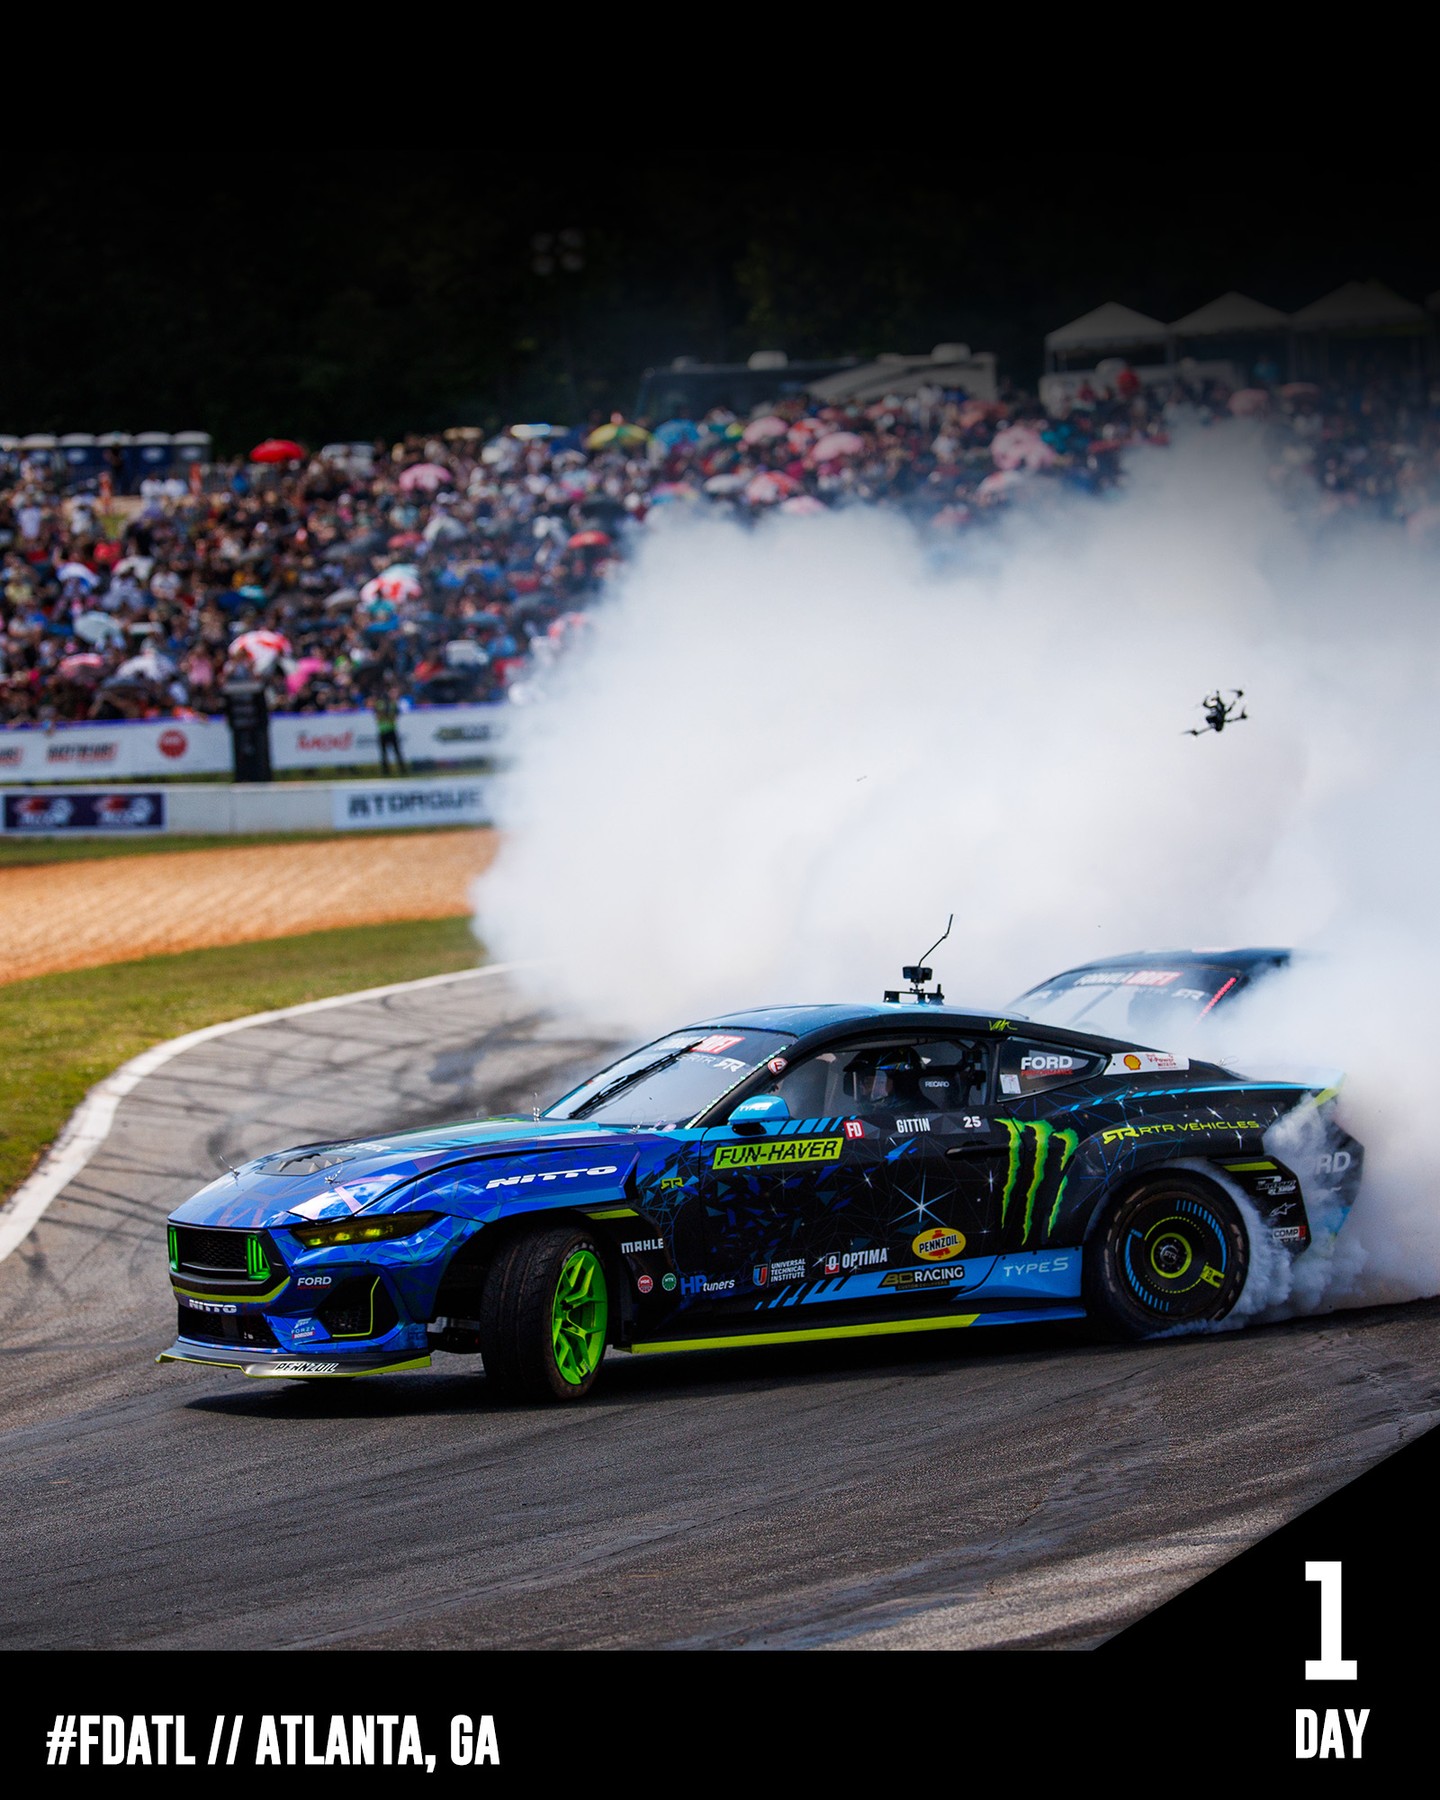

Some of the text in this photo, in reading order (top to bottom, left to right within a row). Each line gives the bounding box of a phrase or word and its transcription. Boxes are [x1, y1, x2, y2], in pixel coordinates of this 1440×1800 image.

[1021, 1055, 1073, 1070] FORD
[925, 1080, 949, 1088] RECARO
[896, 1117, 931, 1134] GITTIN
[963, 1115, 982, 1128] 25
[1139, 1124, 1176, 1136] RTR
[1176, 1120, 1260, 1132] VEHICLES
[717, 1140, 838, 1166] FUN-HAVER
[485, 1165, 618, 1190] NITTO
[1274, 1229, 1298, 1238] COMP
[621, 1238, 664, 1254] MAHLE
[919, 1236, 959, 1254] PENNZOIL
[771, 1258, 806, 1270] UNIVERSAL
[842, 1247, 888, 1269] OPTIMA
[770, 1271, 805, 1283] INSTITUTE
[771, 1265, 806, 1276] TECHNICAL
[297, 1276, 332, 1286] FORD
[189, 1299, 237, 1314] NITTO
[291, 1326, 316, 1335] FORZA
[274, 1361, 339, 1374] PENNZOIL
